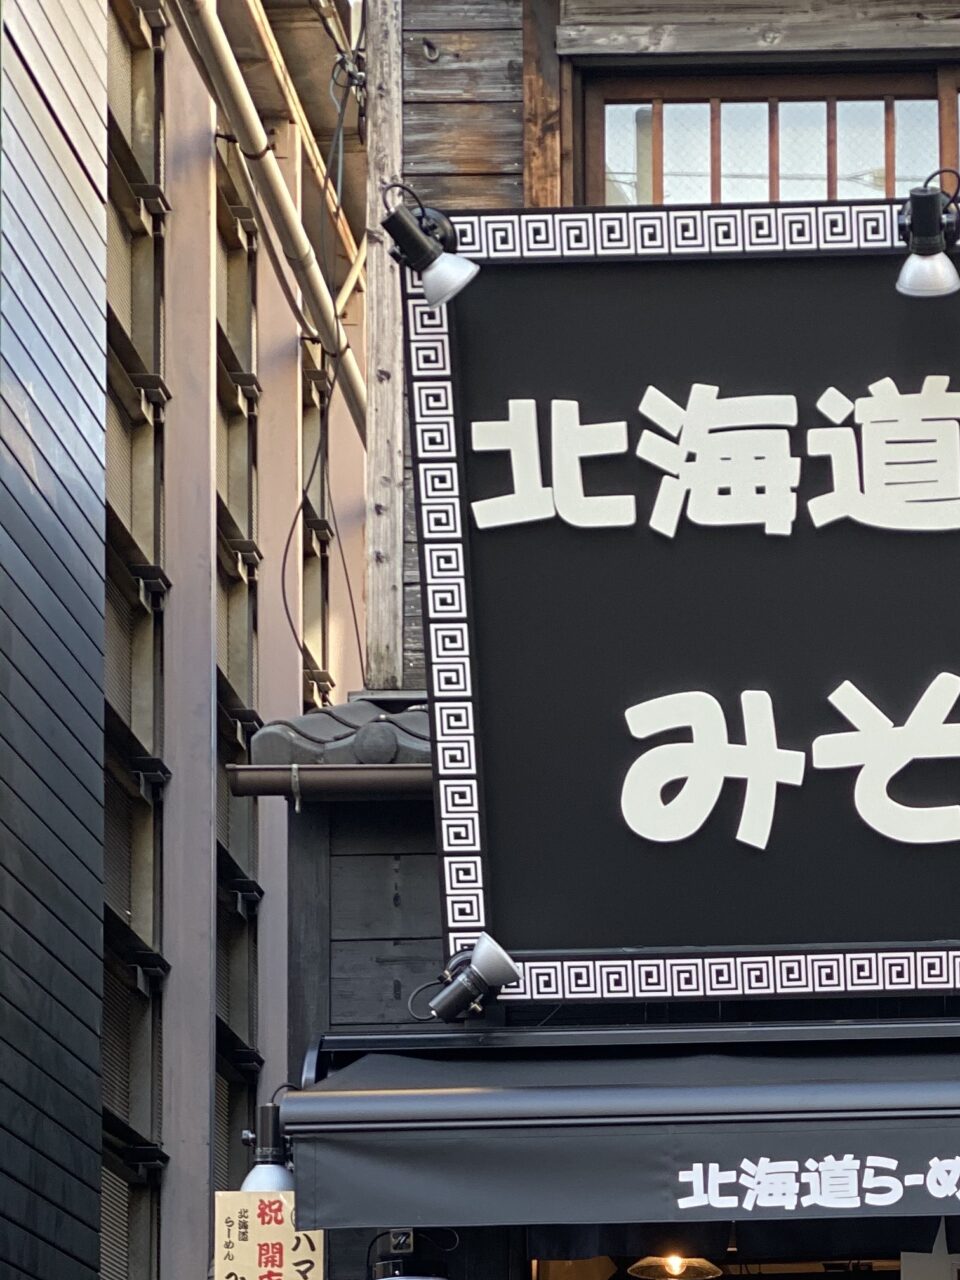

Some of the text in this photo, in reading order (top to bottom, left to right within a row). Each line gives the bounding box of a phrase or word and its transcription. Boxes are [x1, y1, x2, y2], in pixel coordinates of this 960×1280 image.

[257, 1199, 285, 1226] 祝
[223, 1216, 235, 1262] らーめん
